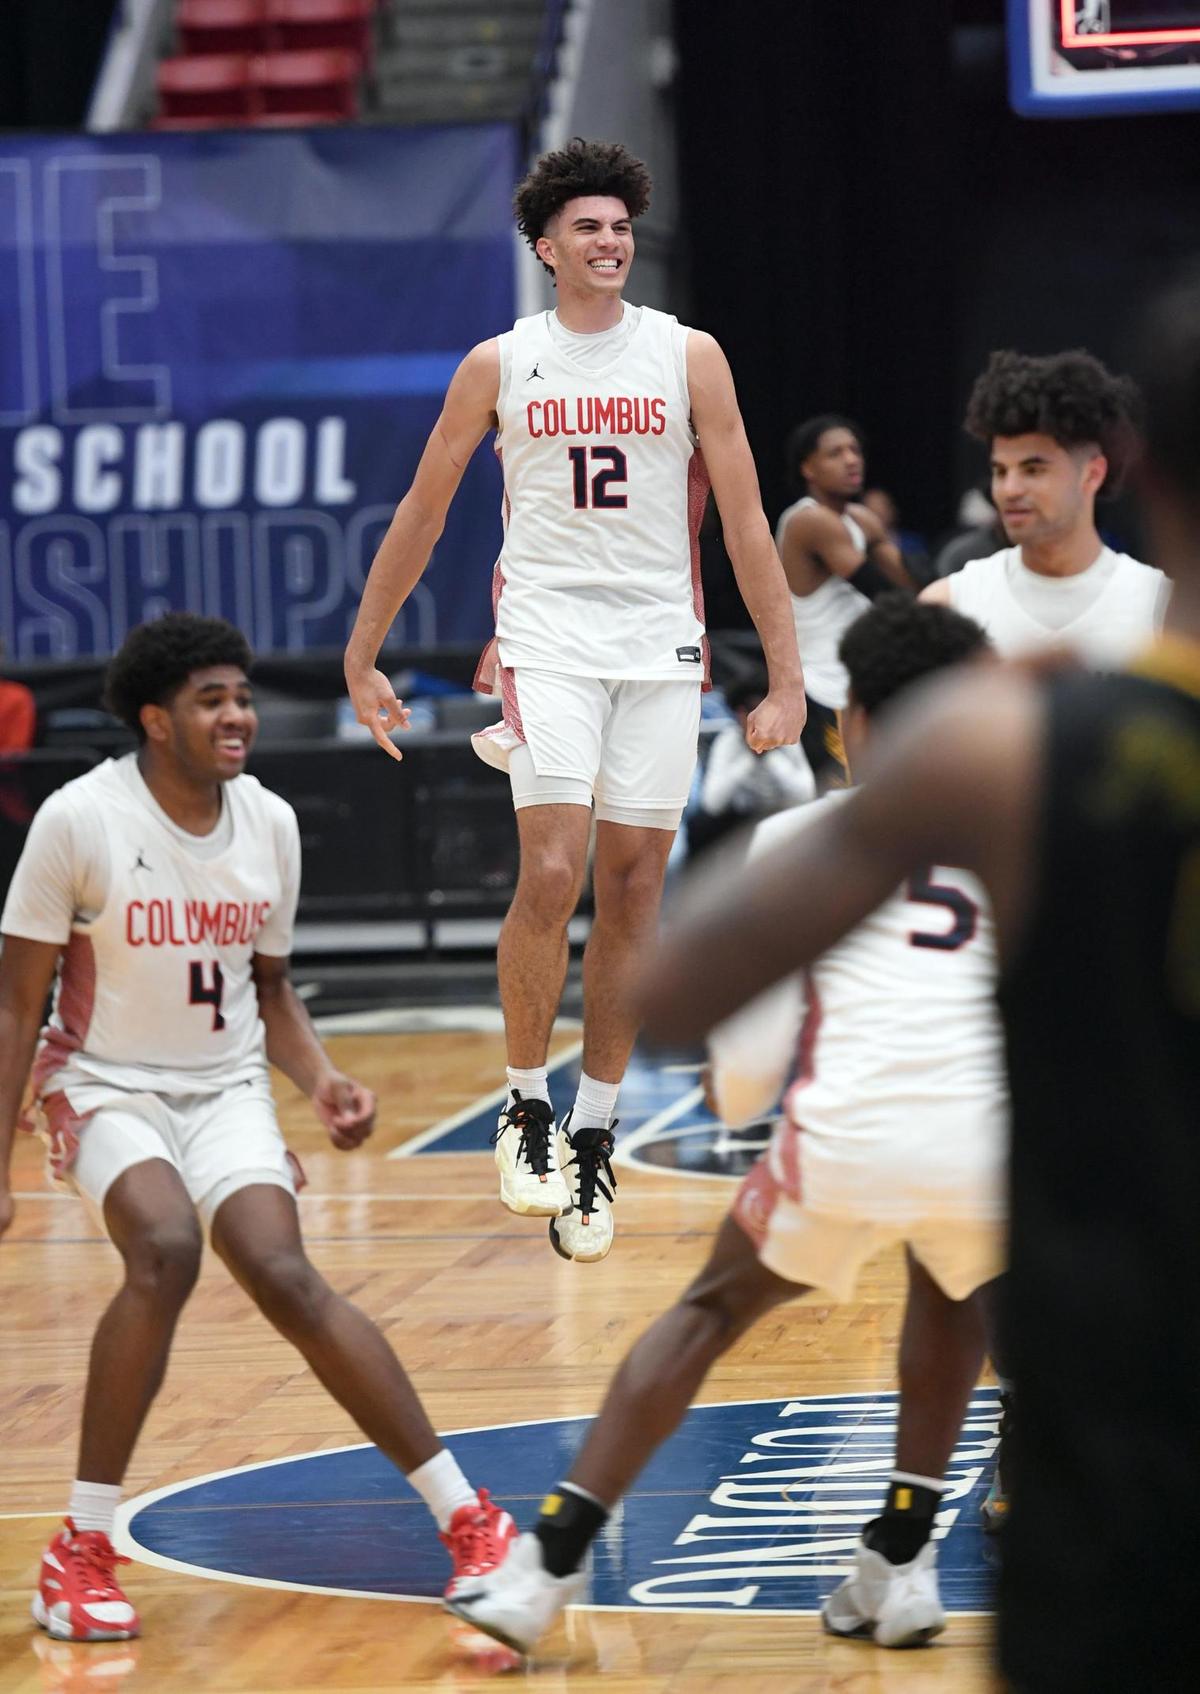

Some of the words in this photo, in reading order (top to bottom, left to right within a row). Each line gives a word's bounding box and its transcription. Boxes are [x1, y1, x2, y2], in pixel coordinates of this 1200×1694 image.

[526, 397, 666, 438] COLUMBUS
[13, 416, 356, 514] SCHOOL
[568, 445, 628, 509] 12
[907, 865, 978, 952] 5
[188, 960, 225, 1032] 4
